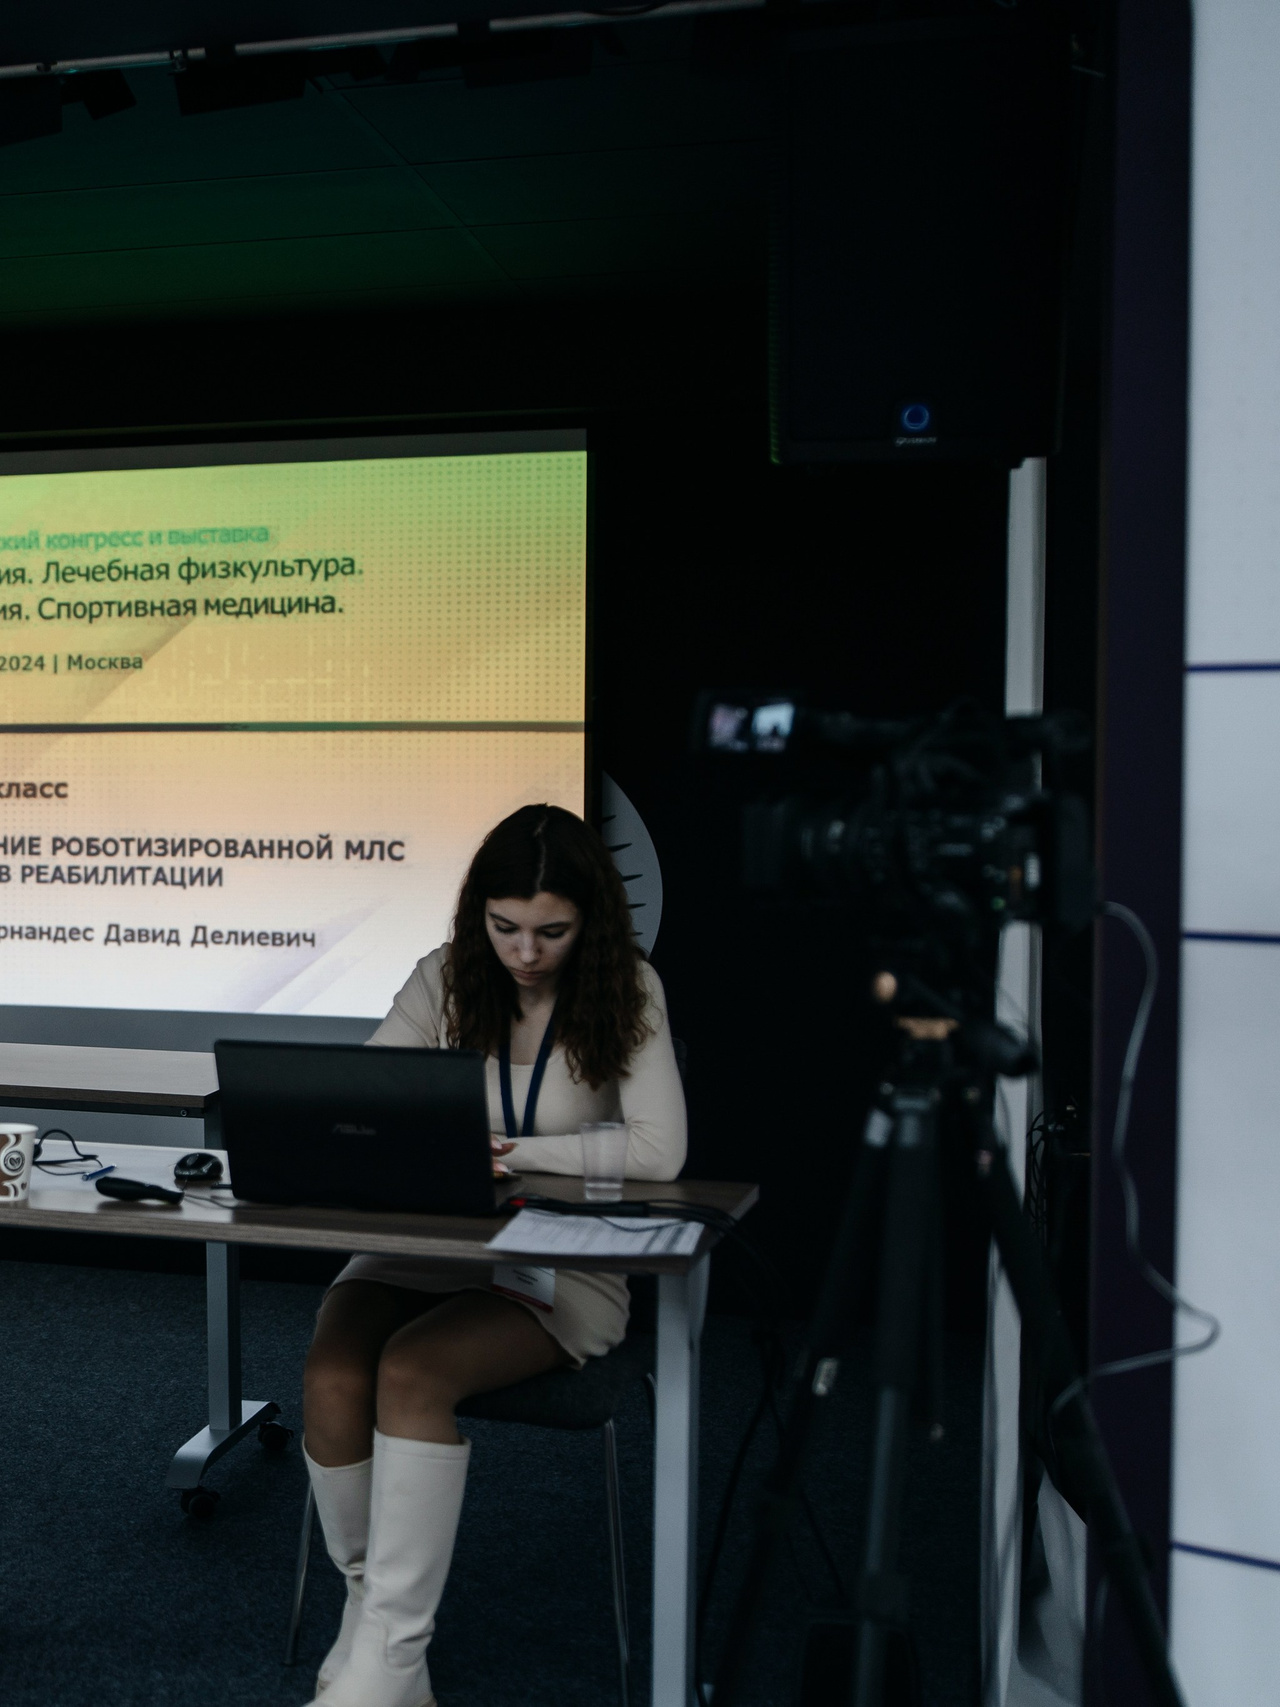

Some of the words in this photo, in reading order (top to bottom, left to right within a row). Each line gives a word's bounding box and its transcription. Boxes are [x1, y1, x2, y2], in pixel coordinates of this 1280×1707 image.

[46, 530, 144, 551] конгресс
[149, 530, 163, 545] и
[168, 526, 270, 545] выставка
[42, 558, 170, 584] Лечебная
[178, 556, 364, 585] физкультура.
[38, 597, 197, 623] Спортивная
[204, 594, 344, 619] медицина.
[67, 653, 144, 671] Москва
[51, 833, 334, 860] РОБОТИЗИРОВАННОЙ
[345, 839, 407, 862] МЛС
[21, 864, 224, 890] РЕАБИЛИТАЦИИ
[104, 923, 181, 946] Давид
[191, 925, 317, 948] Делиевич
